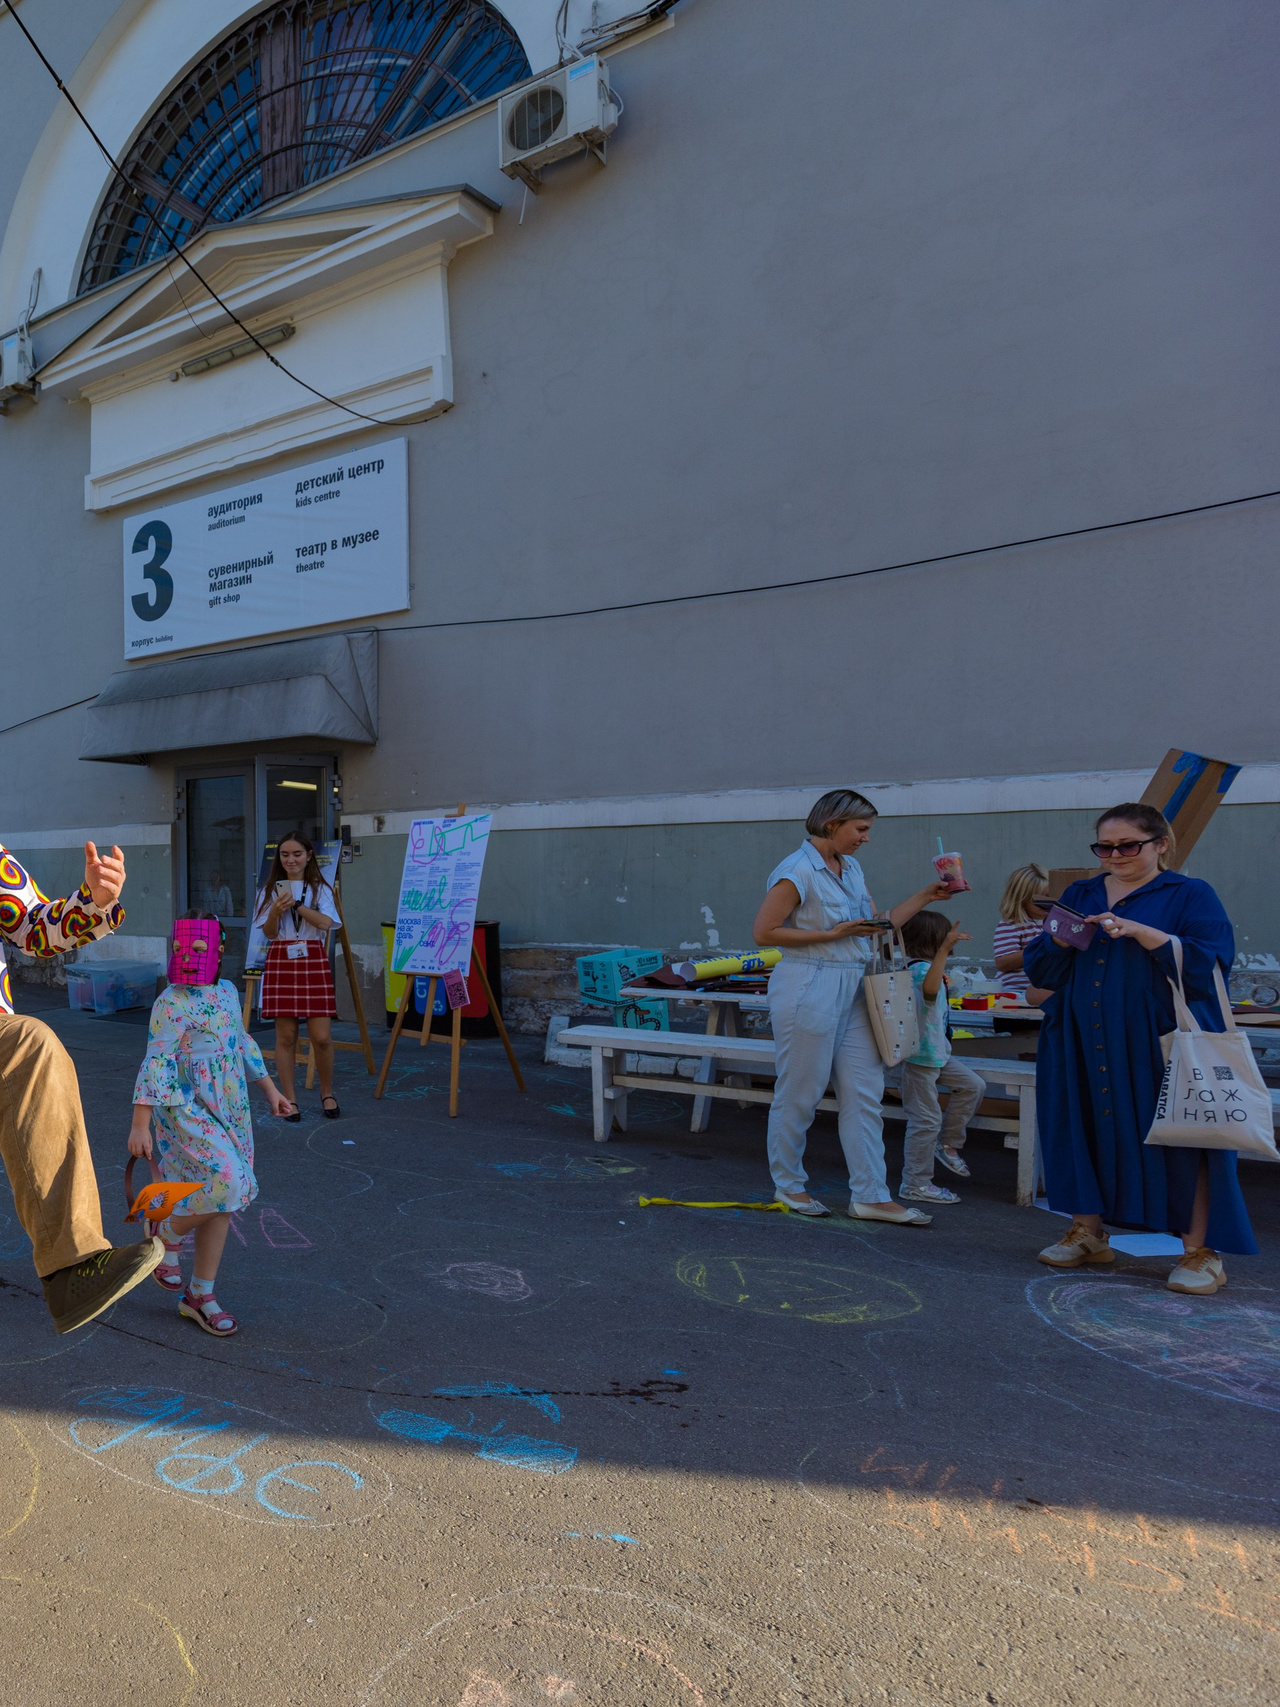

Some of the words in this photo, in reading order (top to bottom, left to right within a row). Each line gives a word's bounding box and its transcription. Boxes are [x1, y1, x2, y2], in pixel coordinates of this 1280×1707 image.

[295, 467, 344, 494] детский
[348, 458, 384, 481] центр
[207, 492, 263, 518] аудитория
[295, 494, 312, 508] kids
[314, 488, 341, 504] centre
[207, 514, 246, 531] auditorium
[295, 542, 327, 558] театр
[331, 539, 338, 550] в
[342, 528, 380, 552] музее
[131, 519, 174, 622] 3
[208, 551, 274, 579] сувенирный
[295, 559, 325, 573] theatre
[209, 573, 253, 593] магазин
[208, 595, 222, 608] gift
[223, 592, 241, 606] shop
[131, 636, 154, 648] корпус
[155, 634, 174, 644] building
[1156, 1059, 1173, 1120] ADIABATICA
